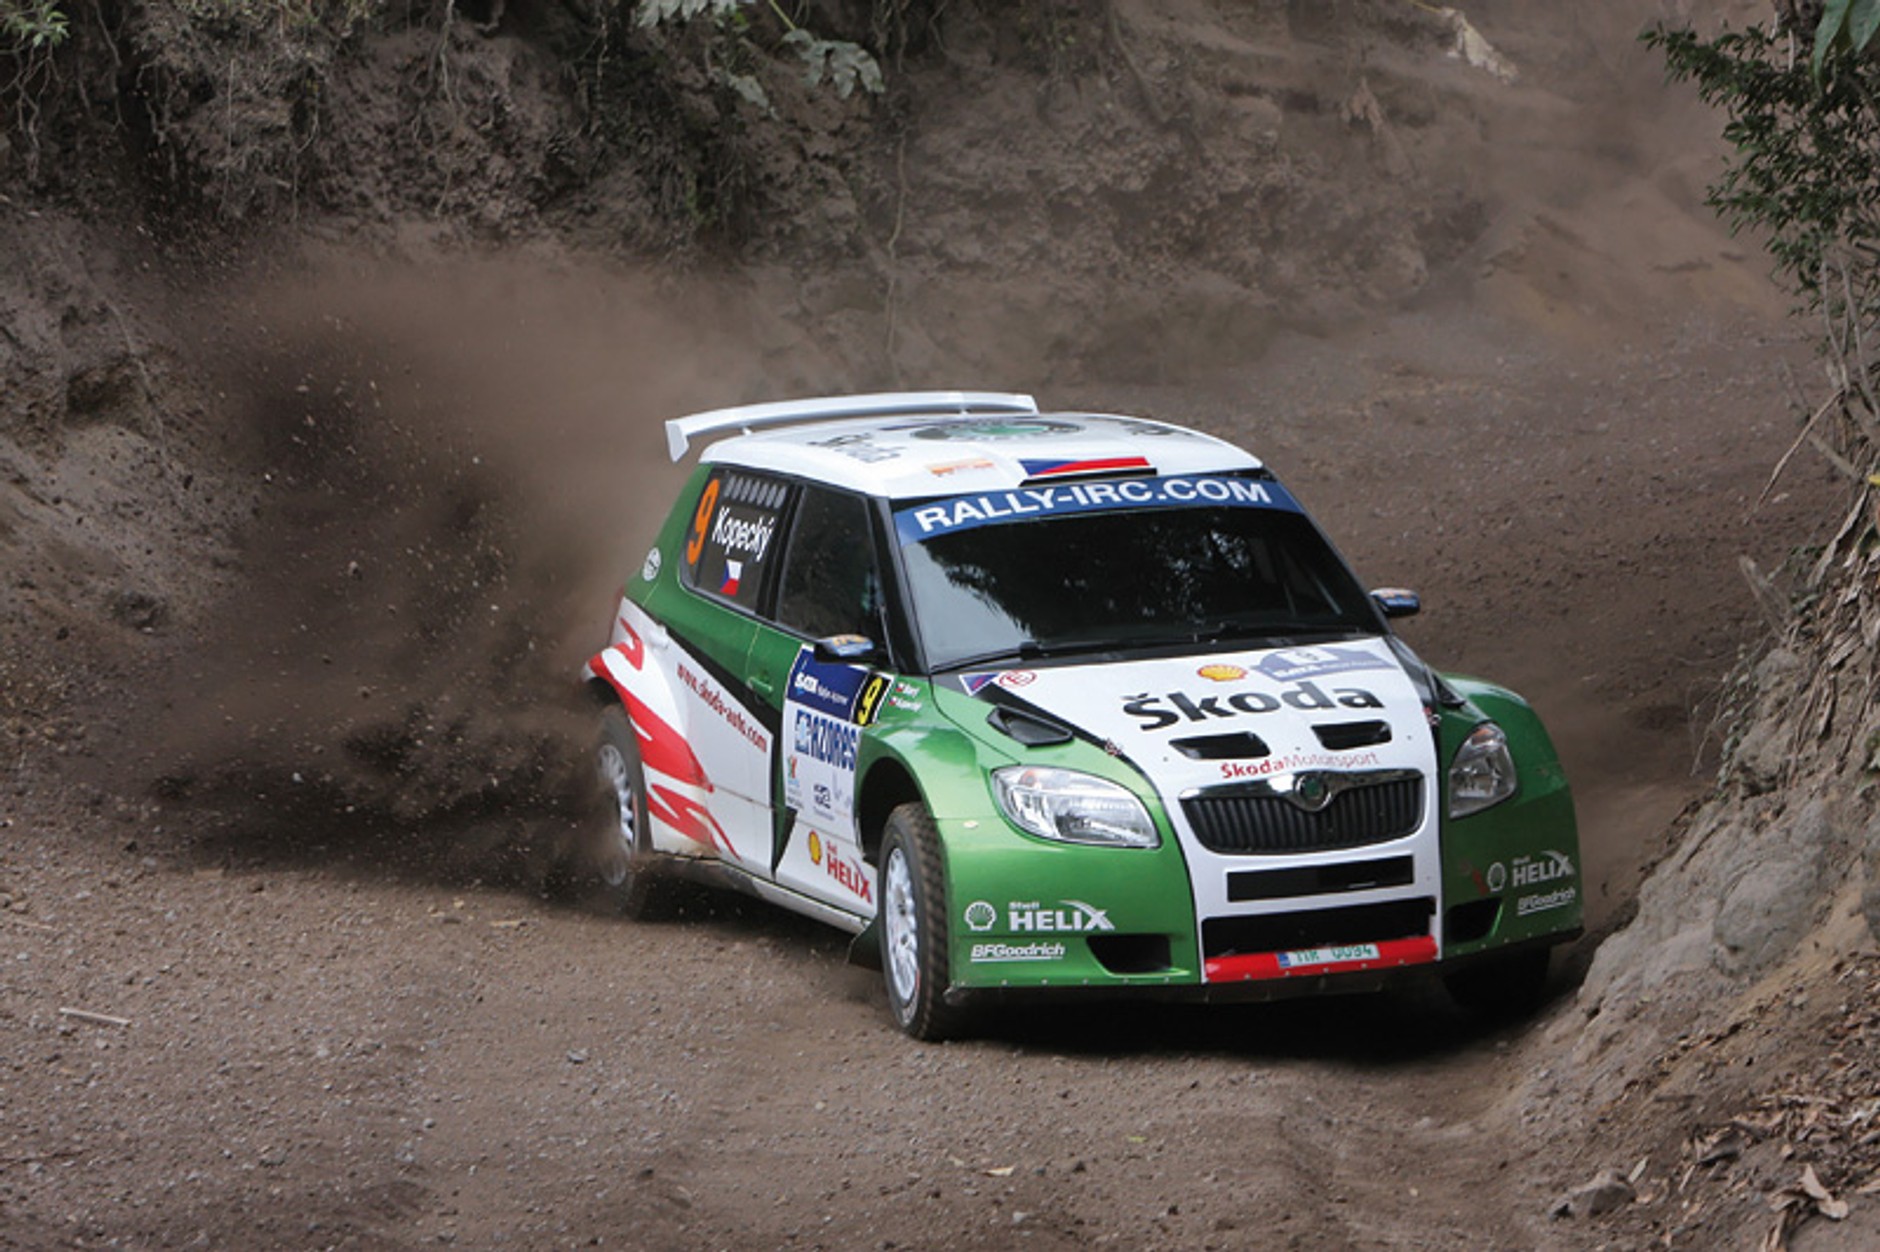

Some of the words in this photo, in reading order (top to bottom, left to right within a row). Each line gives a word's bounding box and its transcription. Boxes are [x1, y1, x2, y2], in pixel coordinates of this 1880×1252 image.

[686, 477, 721, 566] 9
[914, 478, 1273, 532] RALLY-IRC.COM
[711, 504, 776, 563] Kopecký
[857, 676, 883, 726] 9
[1121, 681, 1385, 732] Škoda
[826, 853, 873, 904] HELIX
[1512, 850, 1576, 887] HELIX
[1008, 899, 1116, 931] HELIX
[970, 942, 1066, 962] BFGoodrich
